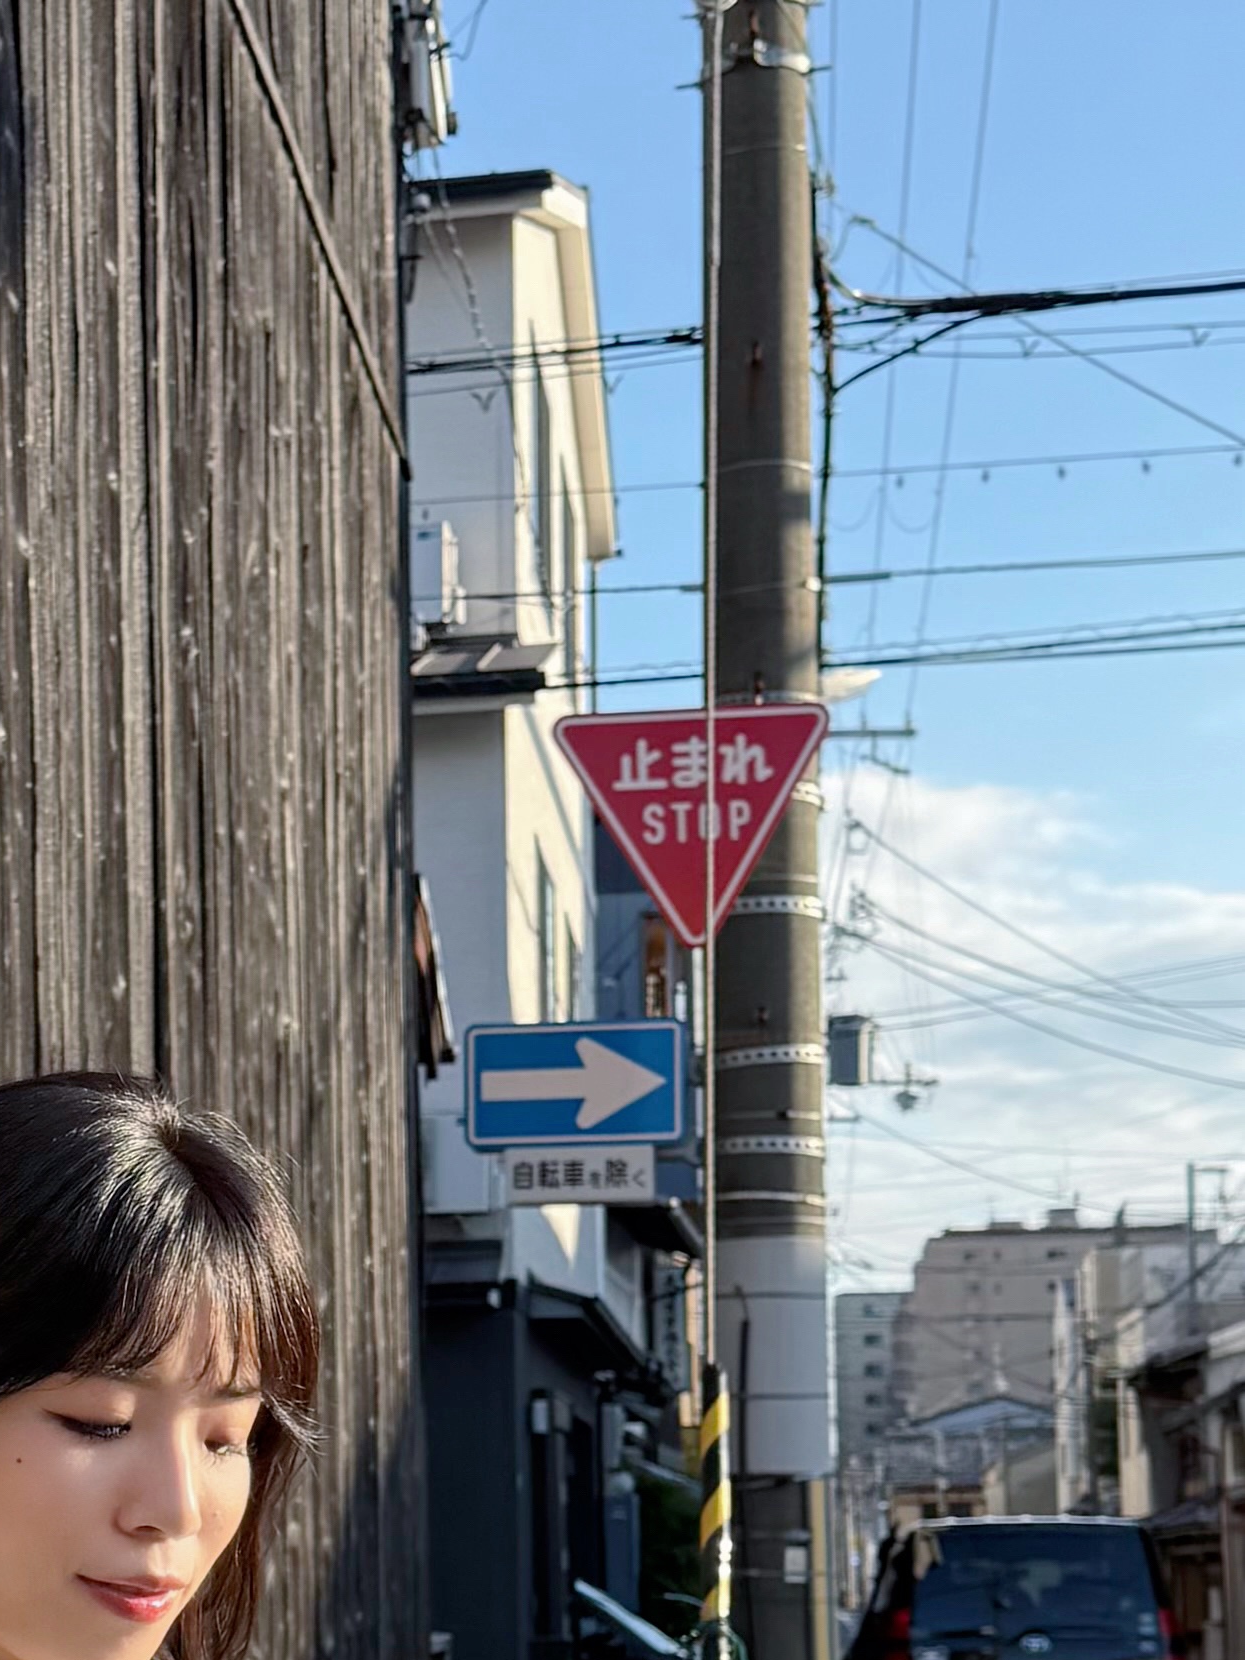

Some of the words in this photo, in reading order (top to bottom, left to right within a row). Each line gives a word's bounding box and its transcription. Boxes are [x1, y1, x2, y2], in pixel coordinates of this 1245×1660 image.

[612, 733, 774, 791] 止まれ
[642, 799, 751, 845] STOP
[513, 1159, 645, 1190] 自転車を除く
